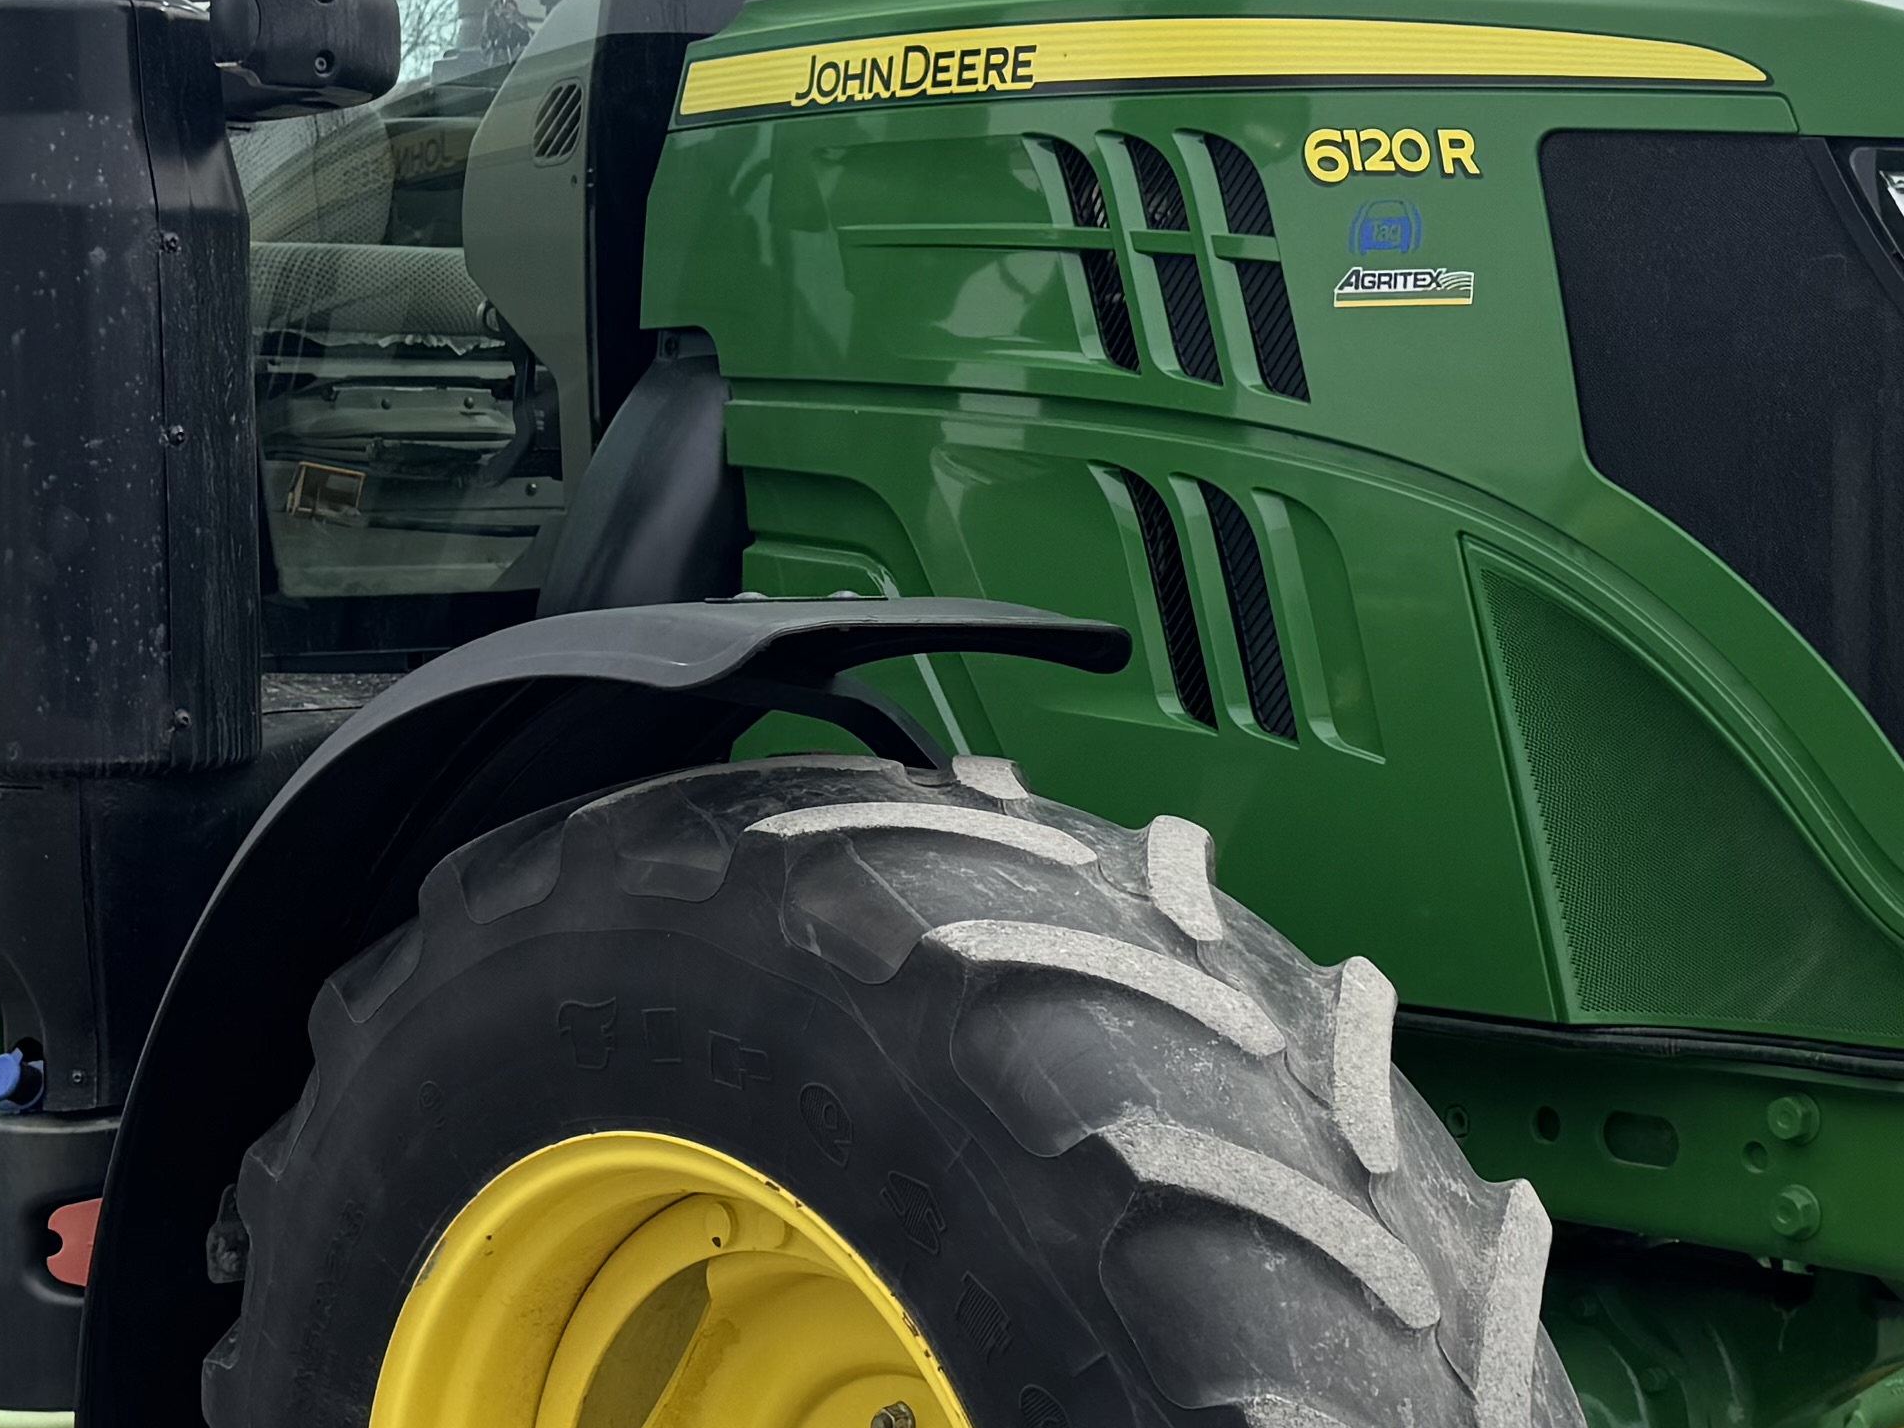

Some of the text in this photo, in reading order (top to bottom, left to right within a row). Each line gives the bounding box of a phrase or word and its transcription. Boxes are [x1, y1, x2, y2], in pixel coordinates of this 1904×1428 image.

[794, 44, 1038, 102] JOHN DEERE
[1304, 128, 1481, 183] 6120 R
[1337, 268, 1445, 291] AGRITEX
